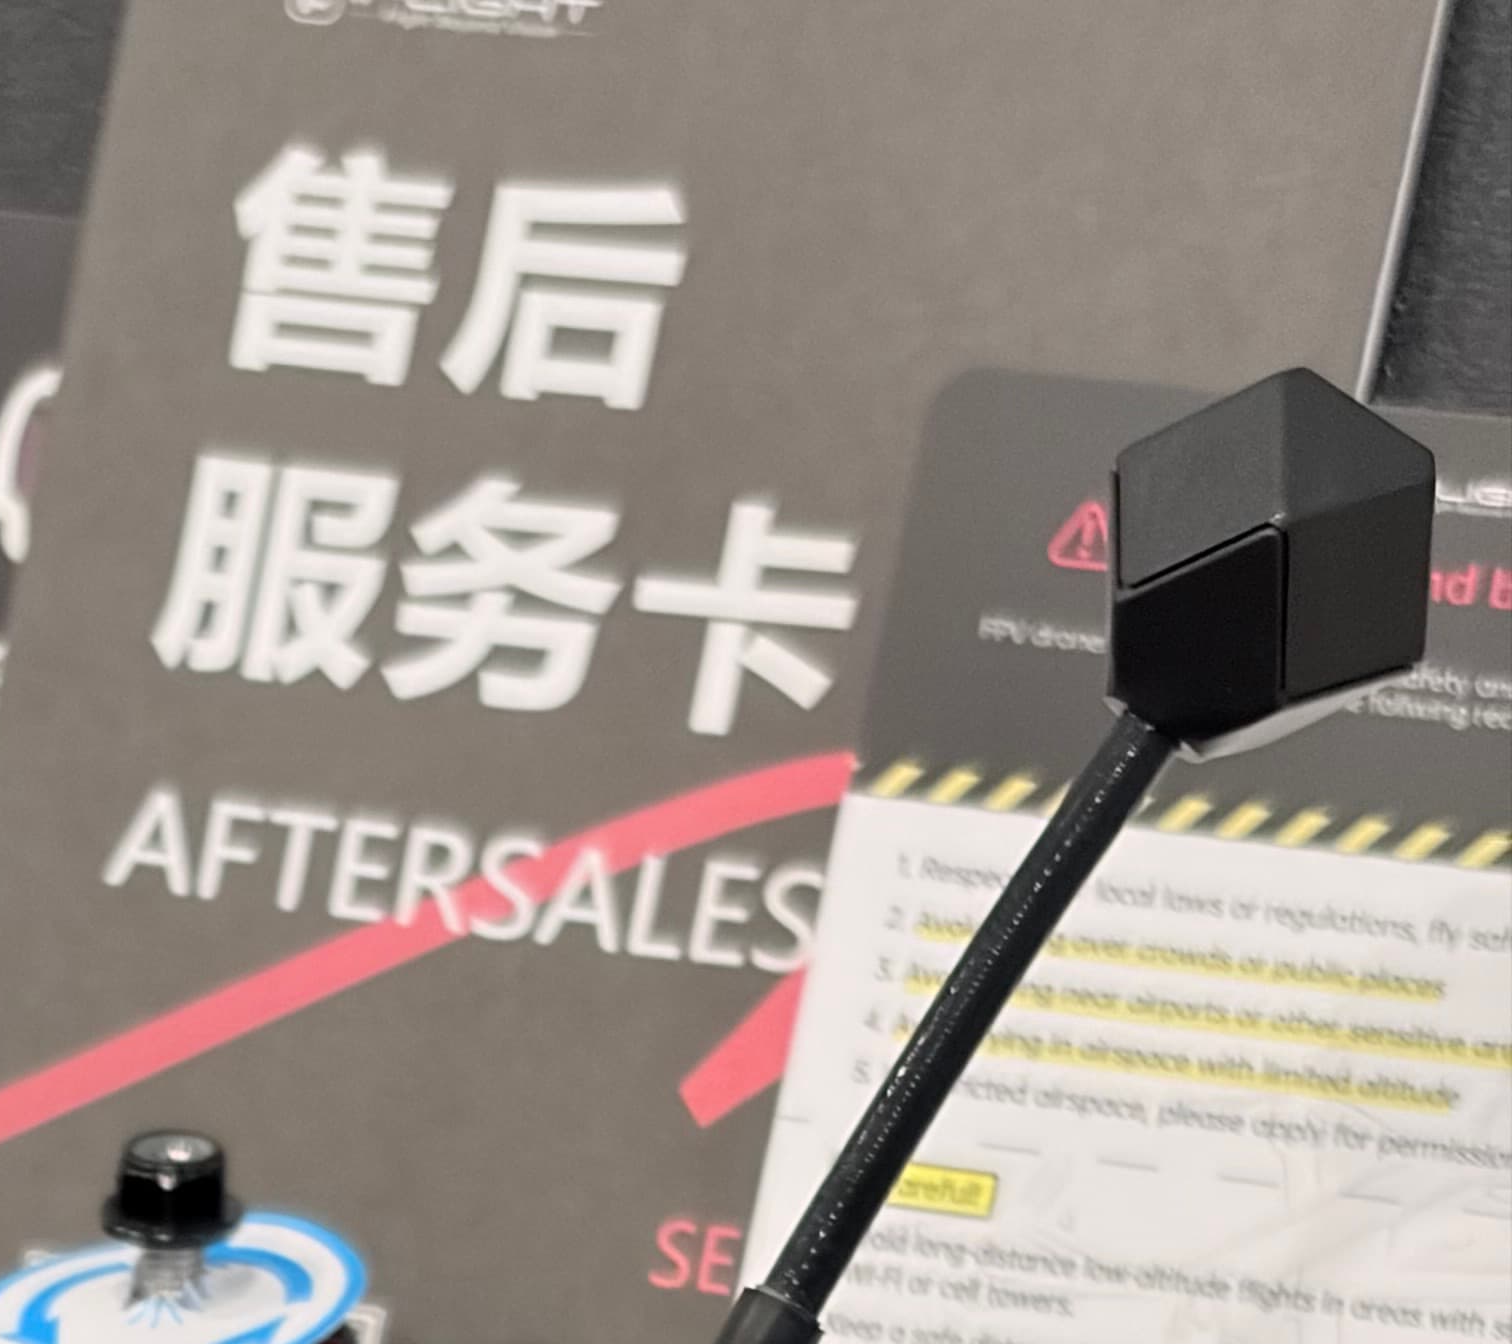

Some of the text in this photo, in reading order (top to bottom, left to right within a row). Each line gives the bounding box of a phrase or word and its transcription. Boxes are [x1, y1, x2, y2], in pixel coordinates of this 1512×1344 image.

[229, 145, 688, 411] 售后
[150, 450, 860, 736] 服务卡
[102, 790, 823, 972] AFTERSALES
[1094, 878, 1157, 908] local
[1162, 885, 1224, 918] laws
[1228, 900, 1259, 921] or
[1155, 1101, 1245, 1132] please
[1249, 1116, 1327, 1149] apply
[1331, 1121, 1374, 1150] for
[908, 1274, 934, 1296] or
[938, 1276, 982, 1304] cell
[914, 1227, 1078, 1273] long-distance
[1083, 1255, 1232, 1300] low-altitude
[1237, 1274, 1317, 1313] flights
[1321, 1289, 1345, 1315] in
[1350, 1299, 1423, 1328] areas
[1429, 1308, 1487, 1337] with
[889, 1324, 906, 1344] a
